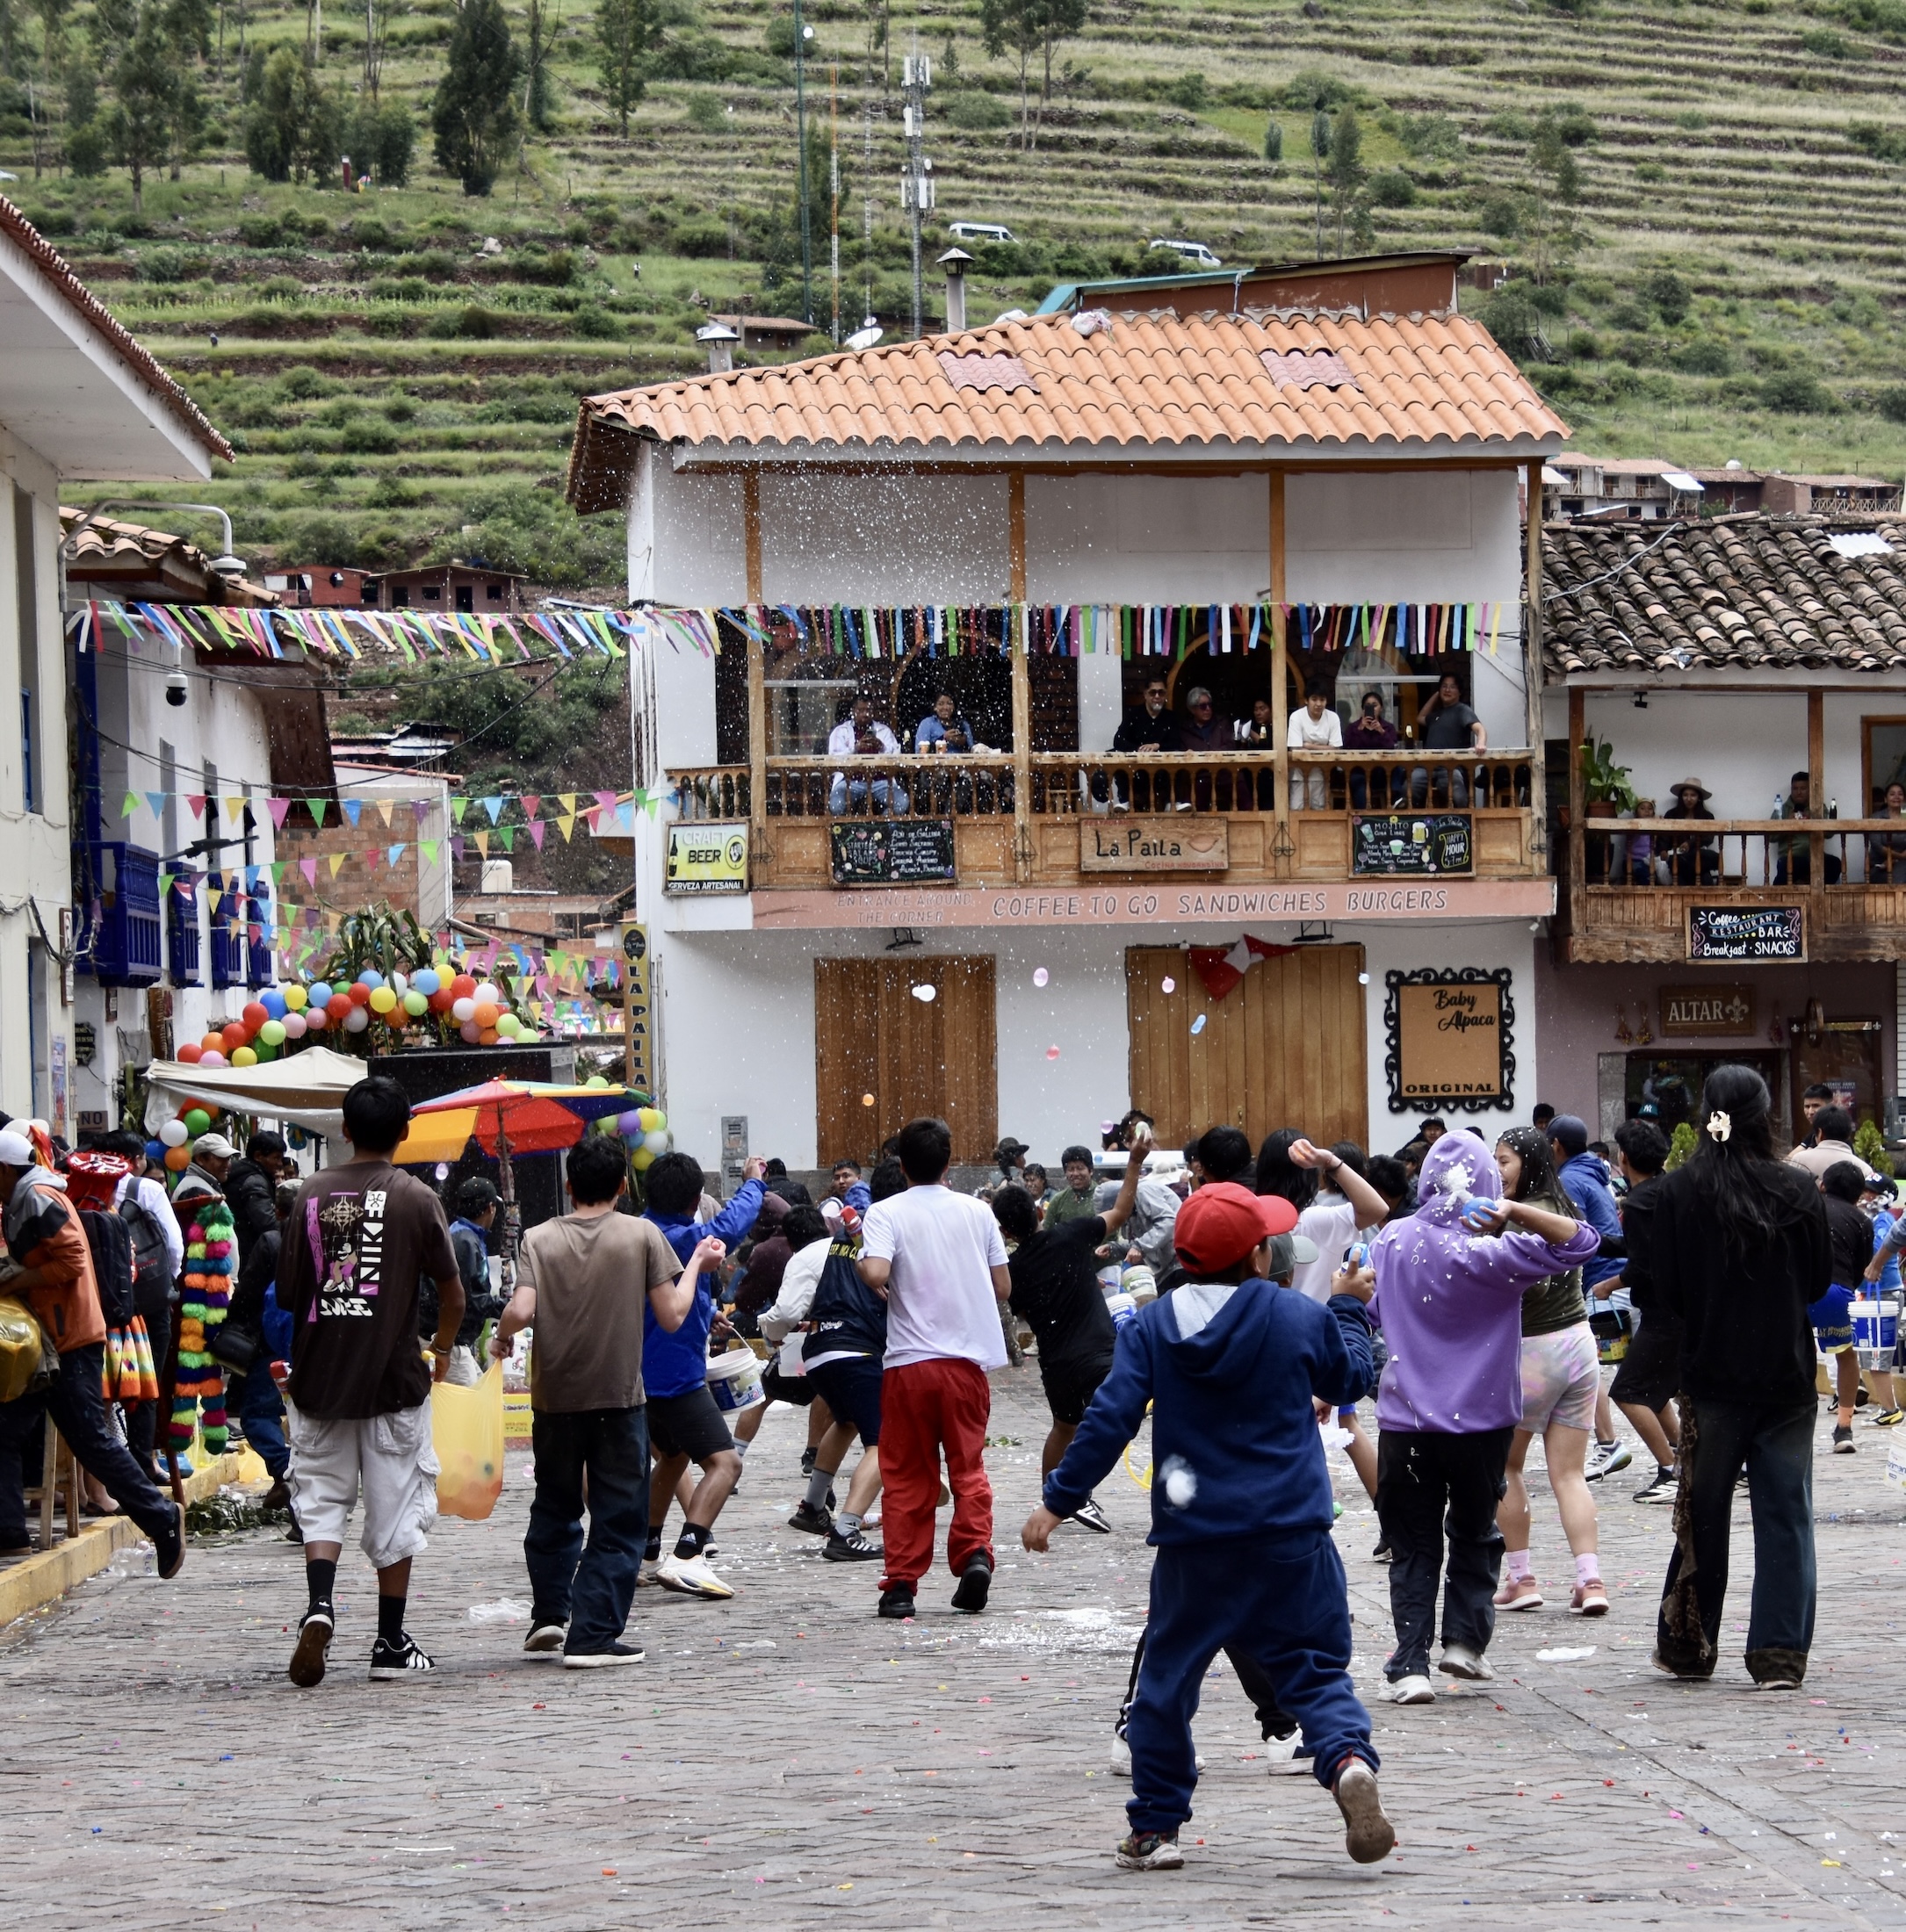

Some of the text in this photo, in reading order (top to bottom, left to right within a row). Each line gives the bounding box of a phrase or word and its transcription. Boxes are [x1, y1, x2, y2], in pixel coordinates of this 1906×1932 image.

[683, 831, 726, 845] CRAFT
[1095, 829, 1120, 857] La
[1447, 833, 1464, 843] HAPPY
[688, 849, 722, 863] BEER
[1445, 842, 1465, 856] HOUR
[853, 856, 878, 865] SOUPS
[668, 881, 740, 890] CERVEZA ARTESANAL
[837, 893, 972, 907] ENTRANCE AROUND
[993, 890, 1448, 917] COFFEE TO GO SANDWICHES BURGERS
[858, 911, 944, 923] THE CORNER
[1707, 911, 1740, 926] Coffee
[1712, 914, 1780, 936] RESTAURANT
[1758, 926, 1782, 938] BAR
[1703, 941, 1795, 958] Breakfast SNACKS
[1433, 990, 1477, 1012] Baby
[1669, 999, 1724, 1021] ALTAR
[628, 965, 647, 1086] LA PAILA
[1438, 1011, 1495, 1033] Alpaca
[1405, 1084, 1494, 1092] ORIGINAL
